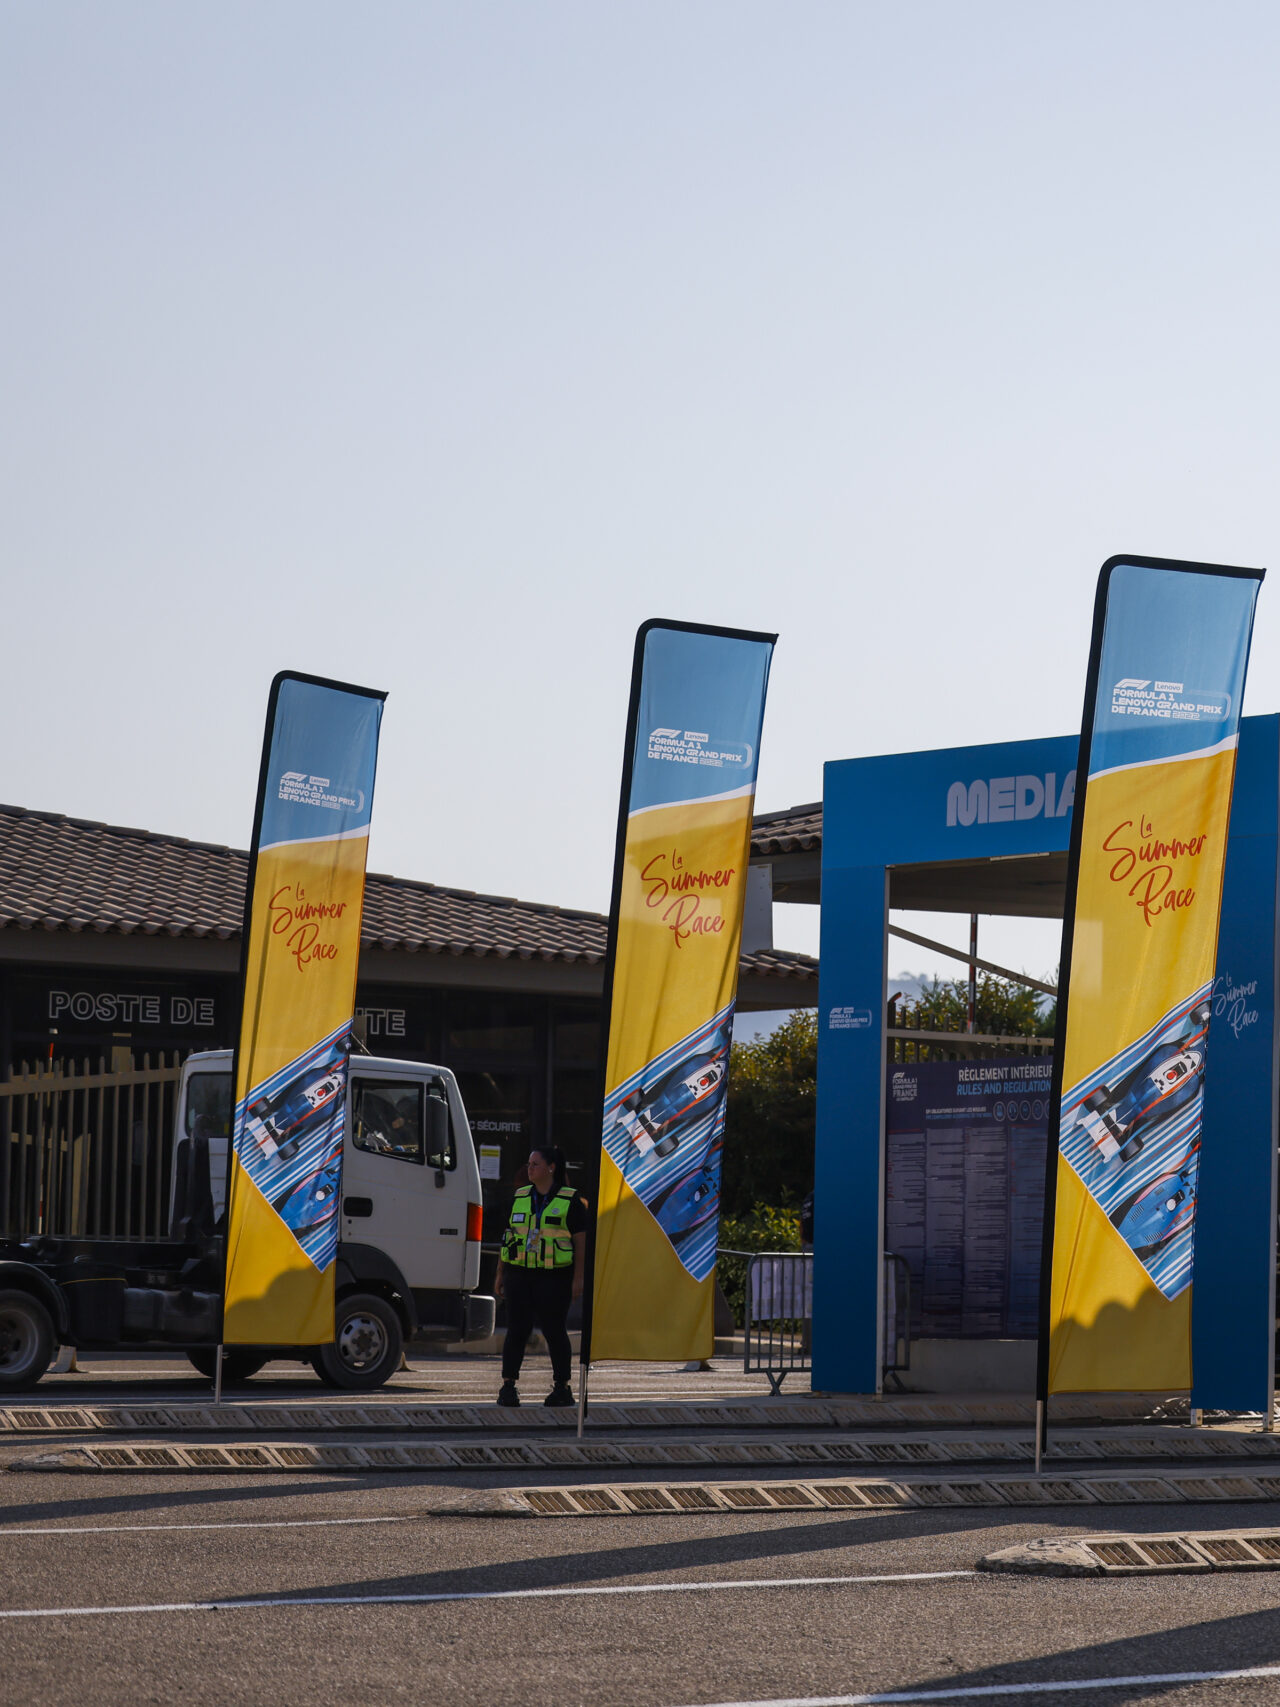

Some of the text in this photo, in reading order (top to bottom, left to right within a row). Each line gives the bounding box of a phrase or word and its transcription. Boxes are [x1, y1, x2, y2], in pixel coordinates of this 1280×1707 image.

[1112, 688, 1175, 701] FORMULA 1
[1156, 682, 1181, 691] Lenovo
[1111, 705, 1126, 714] DE
[1126, 706, 1171, 718] FRANCE
[1112, 697, 1223, 714] LENOVO GRAND PRIX
[647, 751, 660, 759] DE
[661, 752, 698, 764] FRANCE
[648, 743, 742, 762] LENOVO GRAND PRIX
[649, 736, 695, 749] FORMULA
[1102, 820, 1207, 882] Summer
[640, 853, 735, 908] Summer
[1128, 864, 1196, 927] Race
[268, 885, 347, 935] Summer
[662, 893, 726, 949] Race
[286, 922, 338, 973] Race
[49, 991, 215, 1026] POSTE DE
[1211, 976, 1258, 1016] Summer
[1227, 997, 1259, 1040] Race
[956, 1079, 1052, 1096] RULES AND REGULATION
